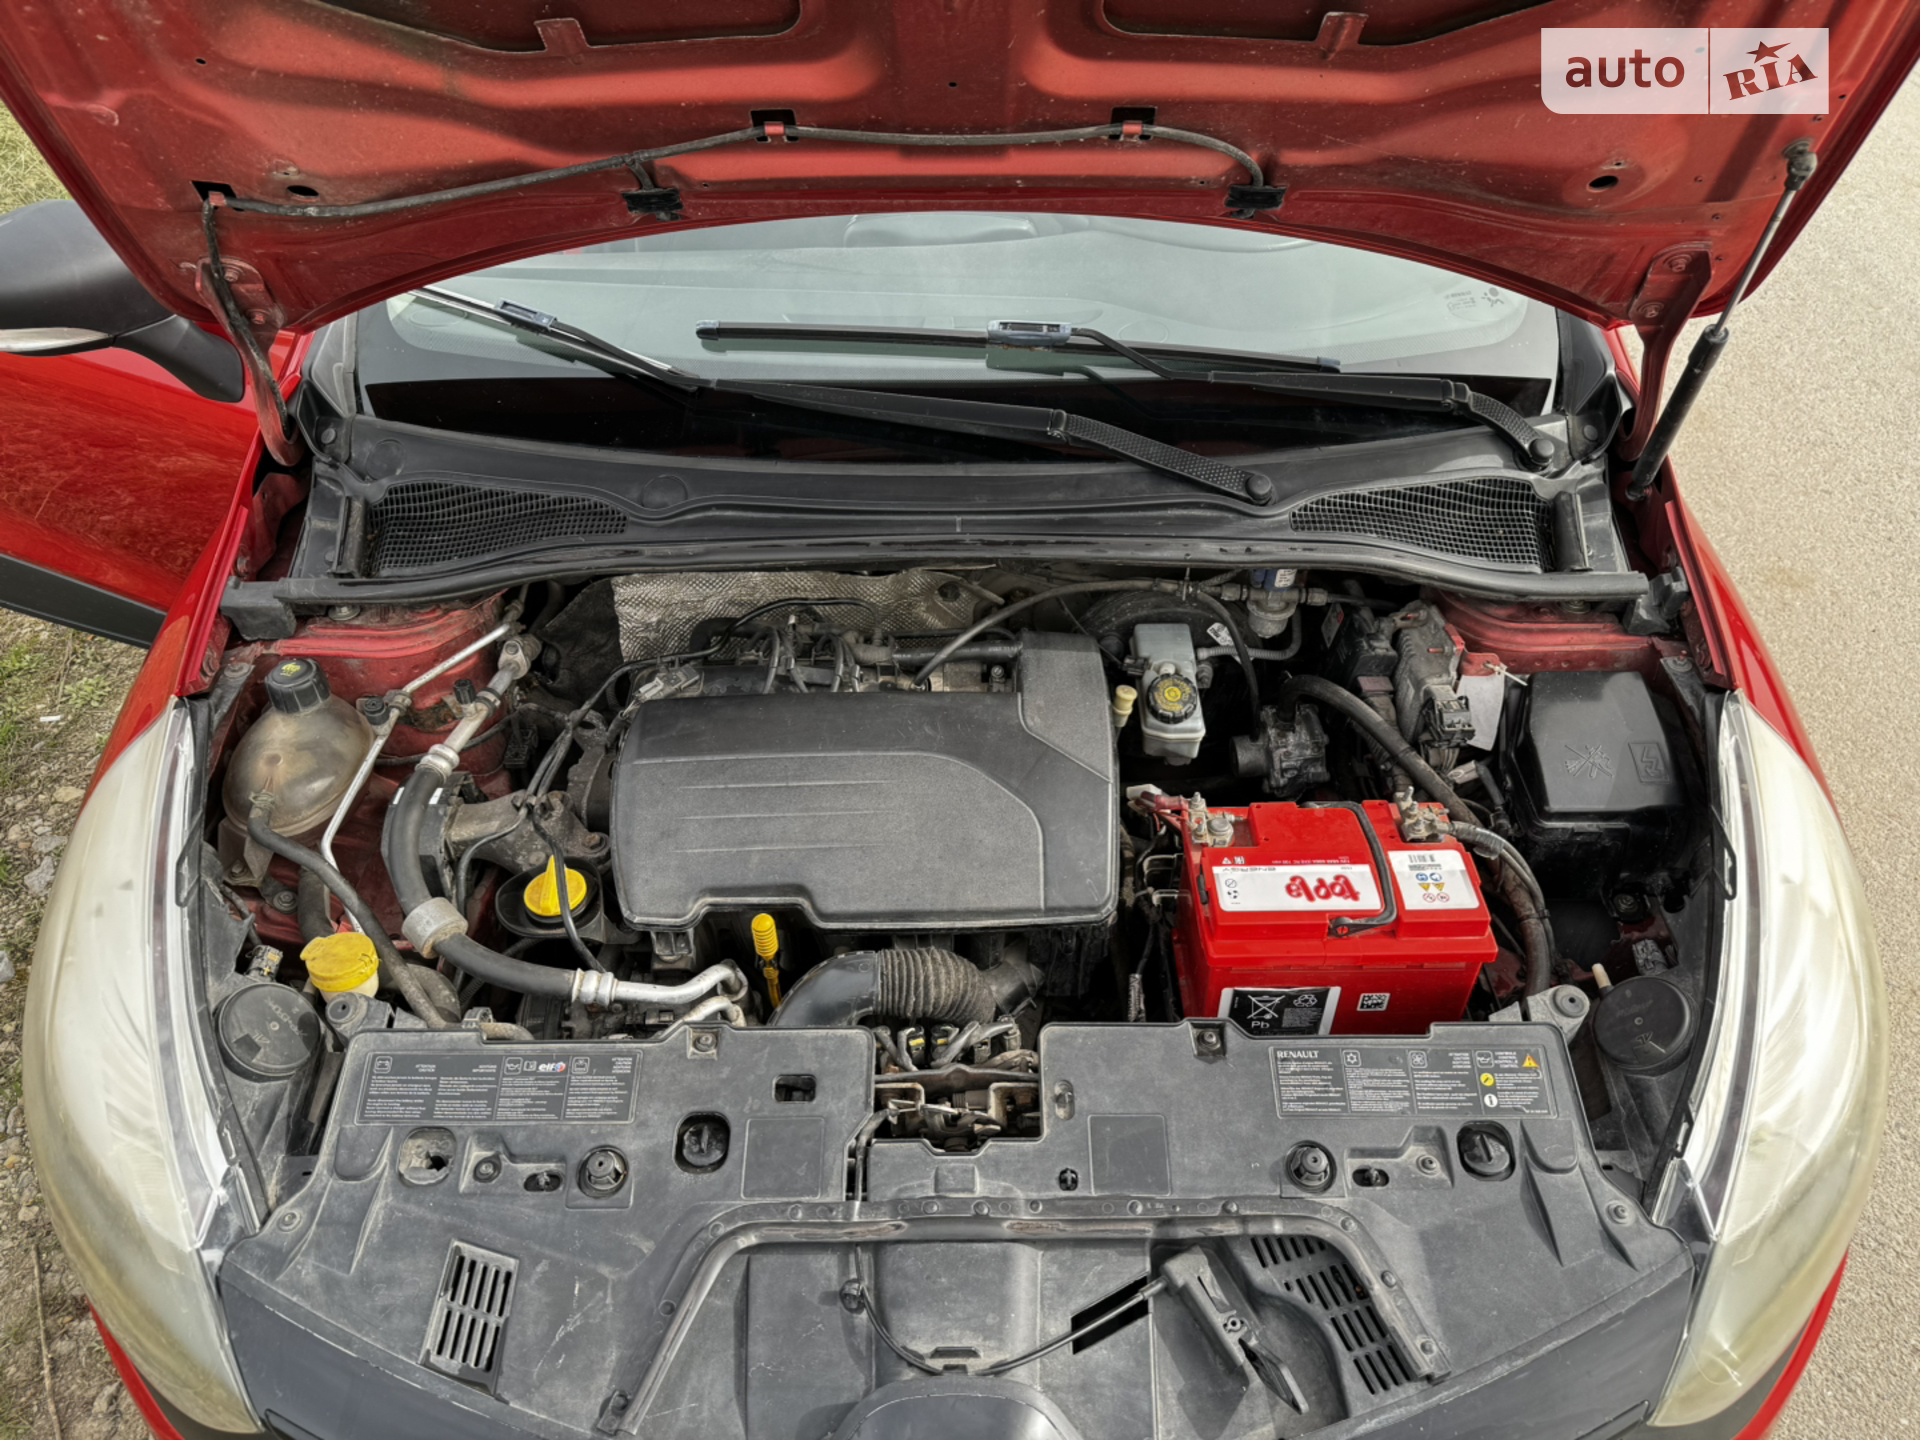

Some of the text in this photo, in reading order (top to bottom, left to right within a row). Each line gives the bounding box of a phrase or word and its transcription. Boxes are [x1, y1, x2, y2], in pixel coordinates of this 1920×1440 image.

[1285, 874, 1360, 902] topla
[1251, 1020, 1270, 1029] Pb
[1276, 1050, 1319, 1059] RENAULT
[538, 1061, 556, 1072] elf
